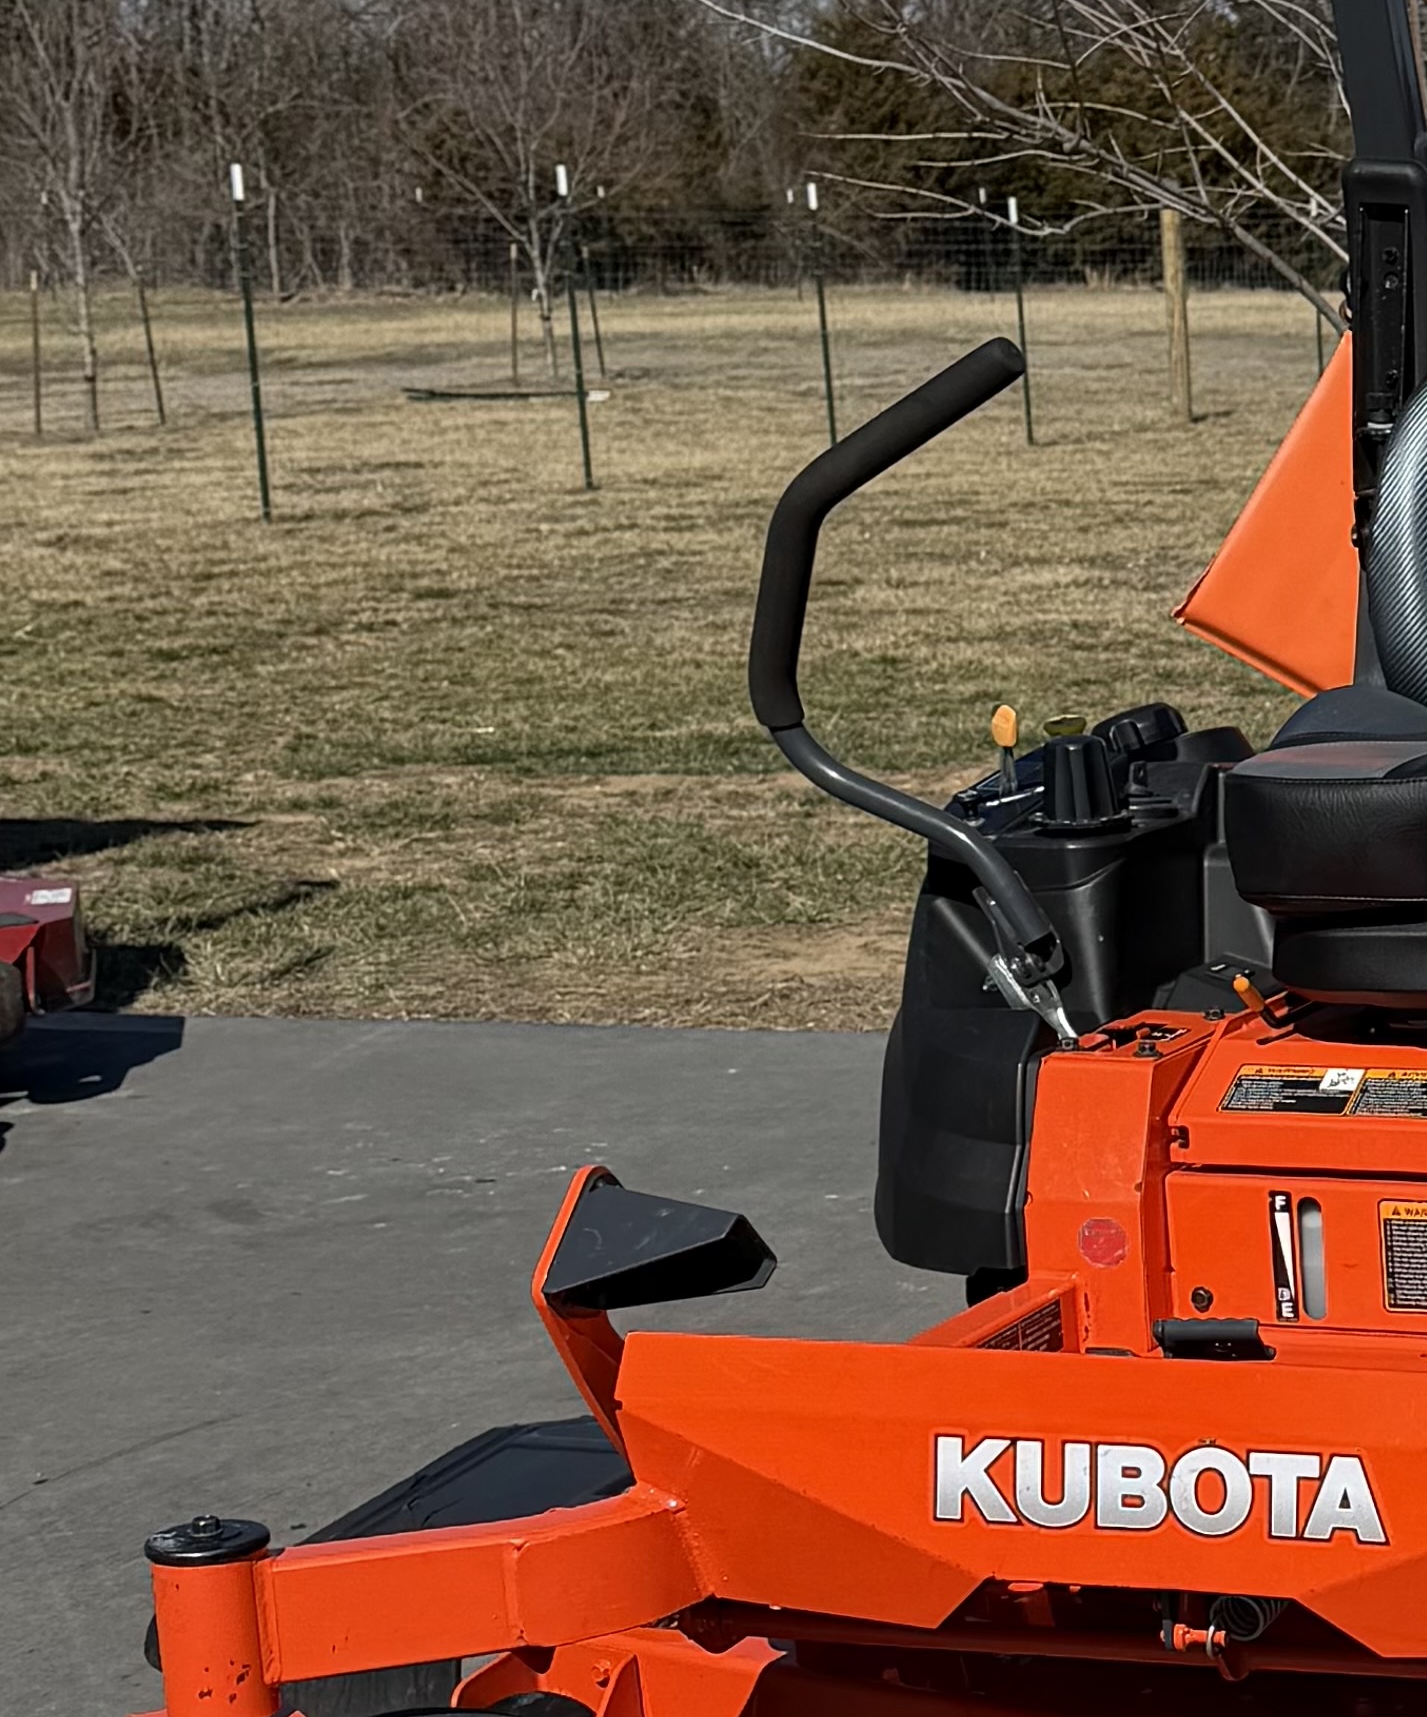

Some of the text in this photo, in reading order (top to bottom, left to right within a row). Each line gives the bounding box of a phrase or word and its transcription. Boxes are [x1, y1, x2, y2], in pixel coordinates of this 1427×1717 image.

[1275, 1195, 1287, 1211] F
[1281, 1302, 1295, 1318] E
[934, 1434, 1389, 1545] KUBOTA
